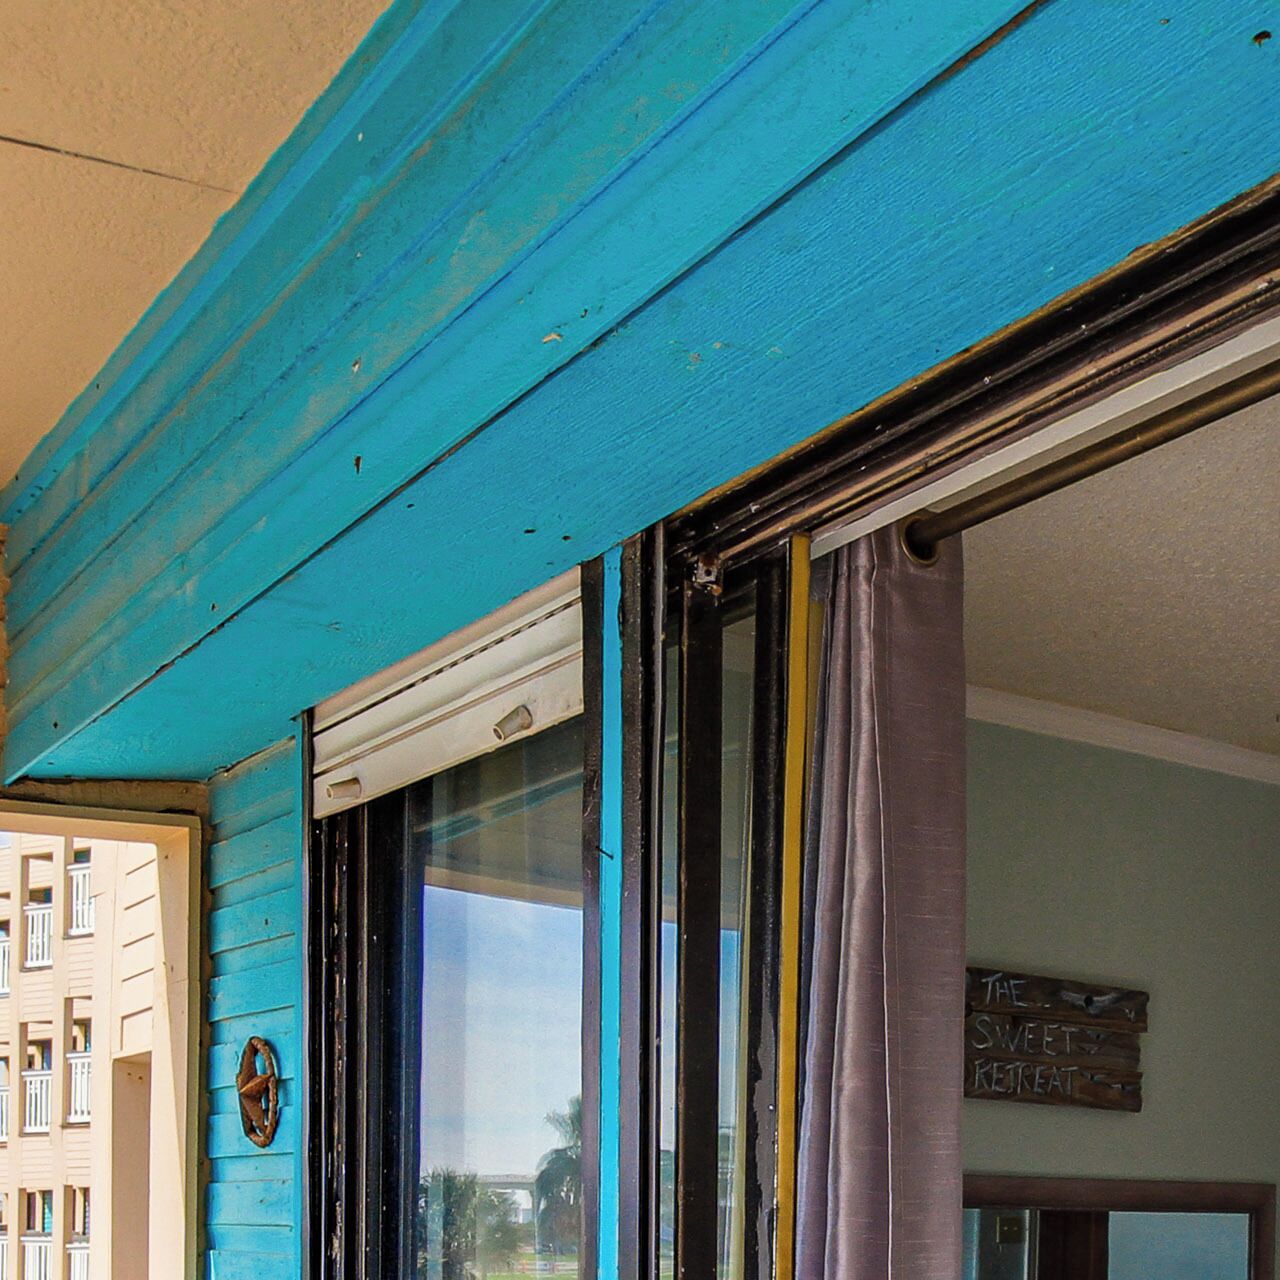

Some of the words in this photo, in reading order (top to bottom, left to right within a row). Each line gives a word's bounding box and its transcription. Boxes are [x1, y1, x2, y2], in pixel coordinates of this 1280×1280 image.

[981, 973, 1029, 1008] THE
[971, 1016, 1080, 1056] SWEET
[975, 1058, 1079, 1095] RETREAT
